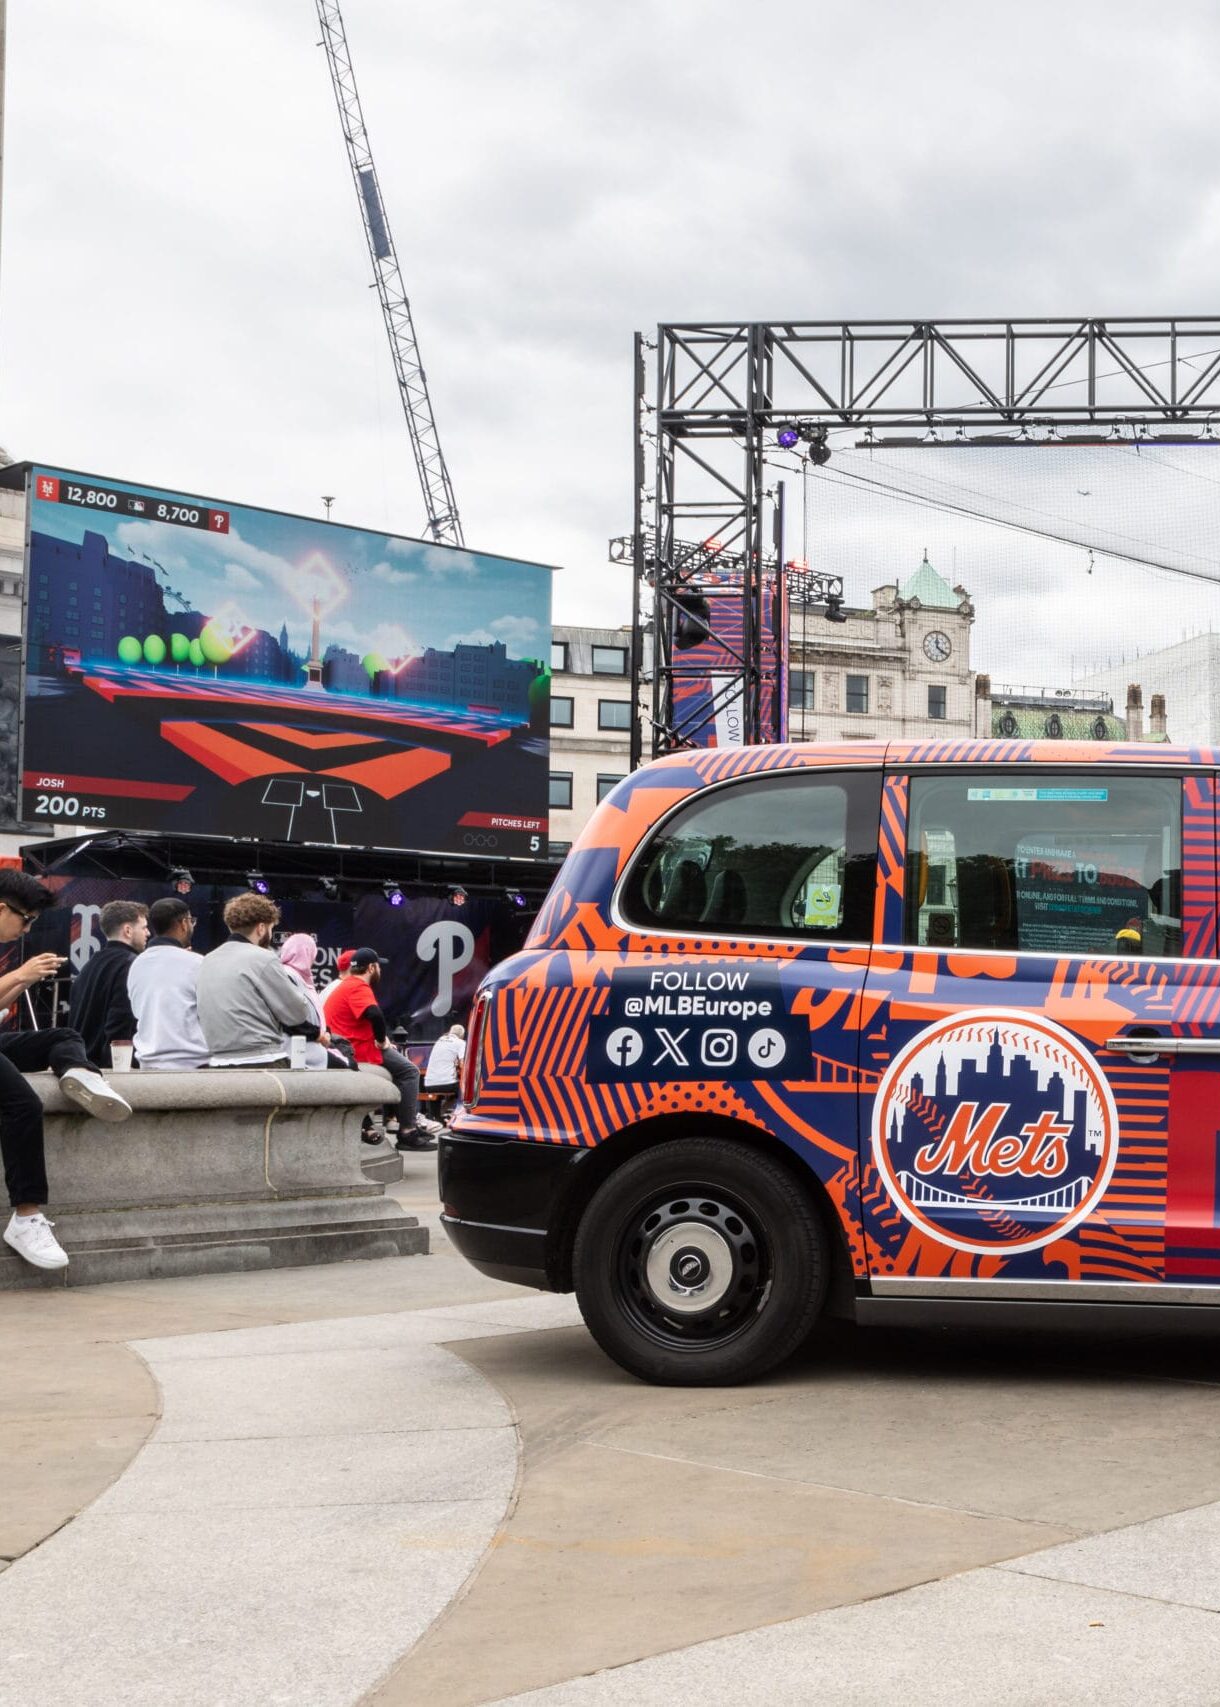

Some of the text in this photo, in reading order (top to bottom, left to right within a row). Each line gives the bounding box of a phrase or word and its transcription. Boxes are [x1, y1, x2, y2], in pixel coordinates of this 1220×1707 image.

[67, 486, 117, 508] 12,800
[157, 504, 199, 523] 8,700
[36, 778, 64, 788] JOSH
[35, 794, 106, 818] 200 PTS
[492, 818, 540, 829] PITCHES LEFT
[530, 836, 539, 851] 5
[650, 971, 749, 991] FOLLOW
[624, 996, 772, 1021] @MLBEurope
[914, 1101, 1075, 1178] Mets
